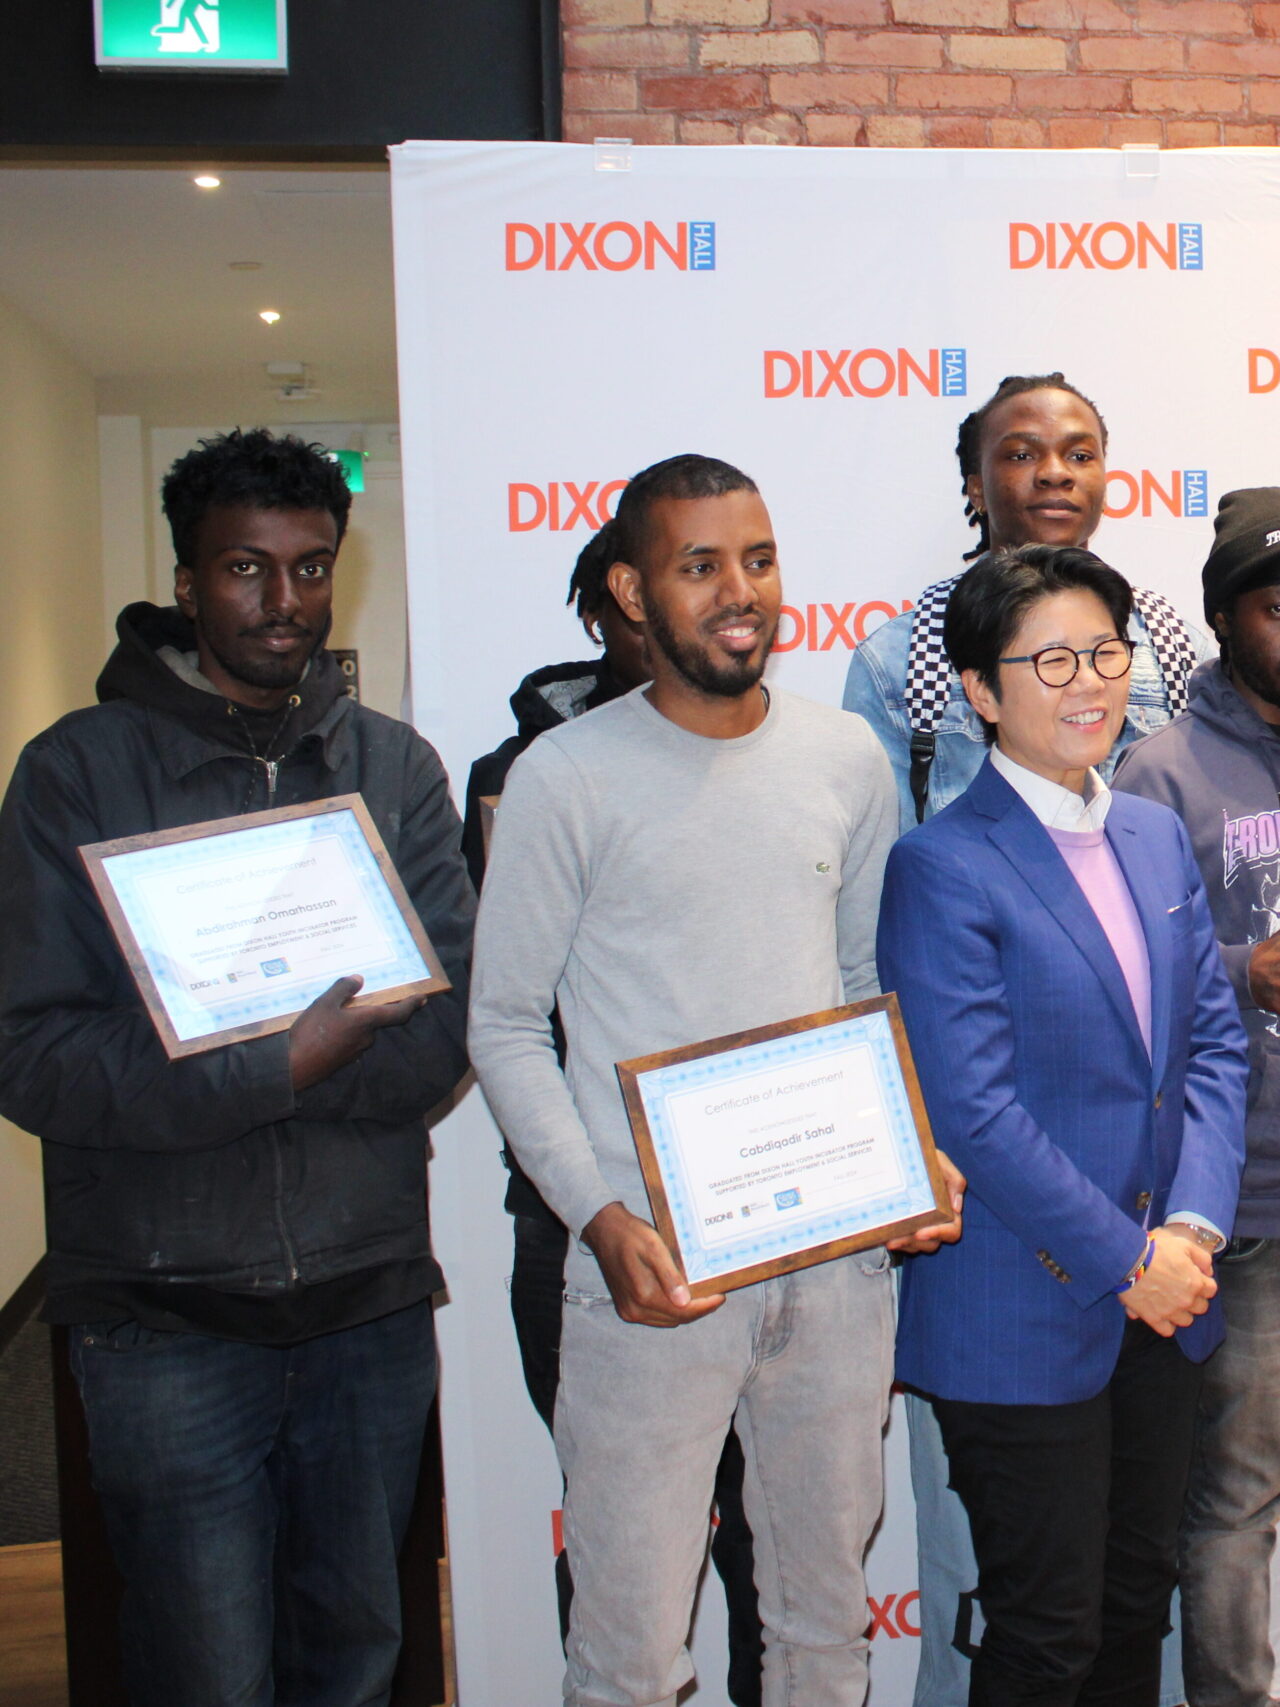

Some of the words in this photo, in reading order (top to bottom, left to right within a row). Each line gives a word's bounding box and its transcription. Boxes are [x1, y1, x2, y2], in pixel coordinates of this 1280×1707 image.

[506, 222, 687, 271] DIXON
[692, 222, 713, 269] HALL
[1010, 222, 1178, 270] DIXON
[1181, 223, 1201, 270] HALL
[765, 349, 939, 398] DIXON
[944, 349, 965, 396] HALL
[508, 479, 632, 532] DIXO
[1185, 471, 1206, 516] HALL
[769, 600, 915, 653] DIXO
[267, 898, 337, 921] Omarhassan
[704, 1094, 761, 1115] Certificate
[762, 1088, 773, 1101] of
[776, 1070, 844, 1097] Achievement
[804, 1123, 836, 1141] Sahal
